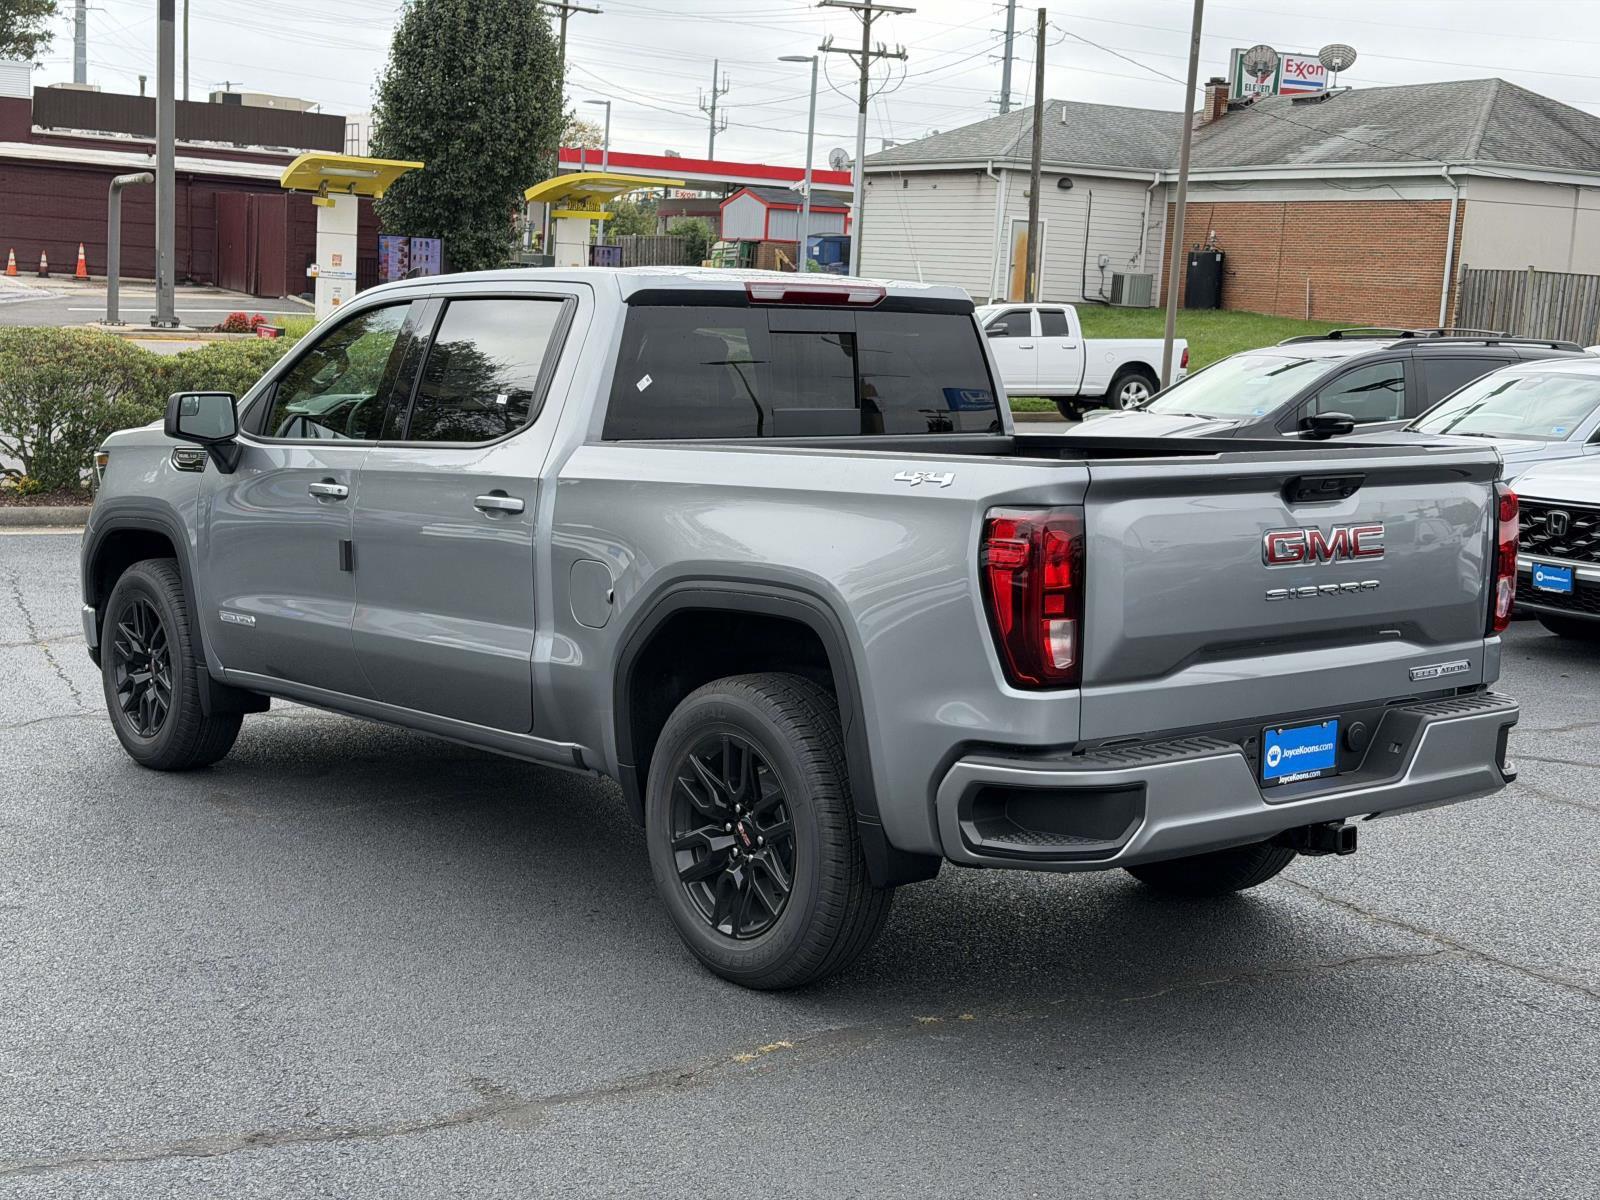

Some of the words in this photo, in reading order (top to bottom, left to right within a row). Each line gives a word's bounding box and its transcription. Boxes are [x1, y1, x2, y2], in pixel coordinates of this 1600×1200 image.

[1285, 58, 1324, 80] Exxon
[675, 190, 697, 200] Exxon
[1262, 523, 1385, 569] GMC
[1265, 579, 1381, 601] SIERRA
[1282, 742, 1333, 758] JoyceKoons.com
[1278, 770, 1321, 784] JoyceKoons.com
